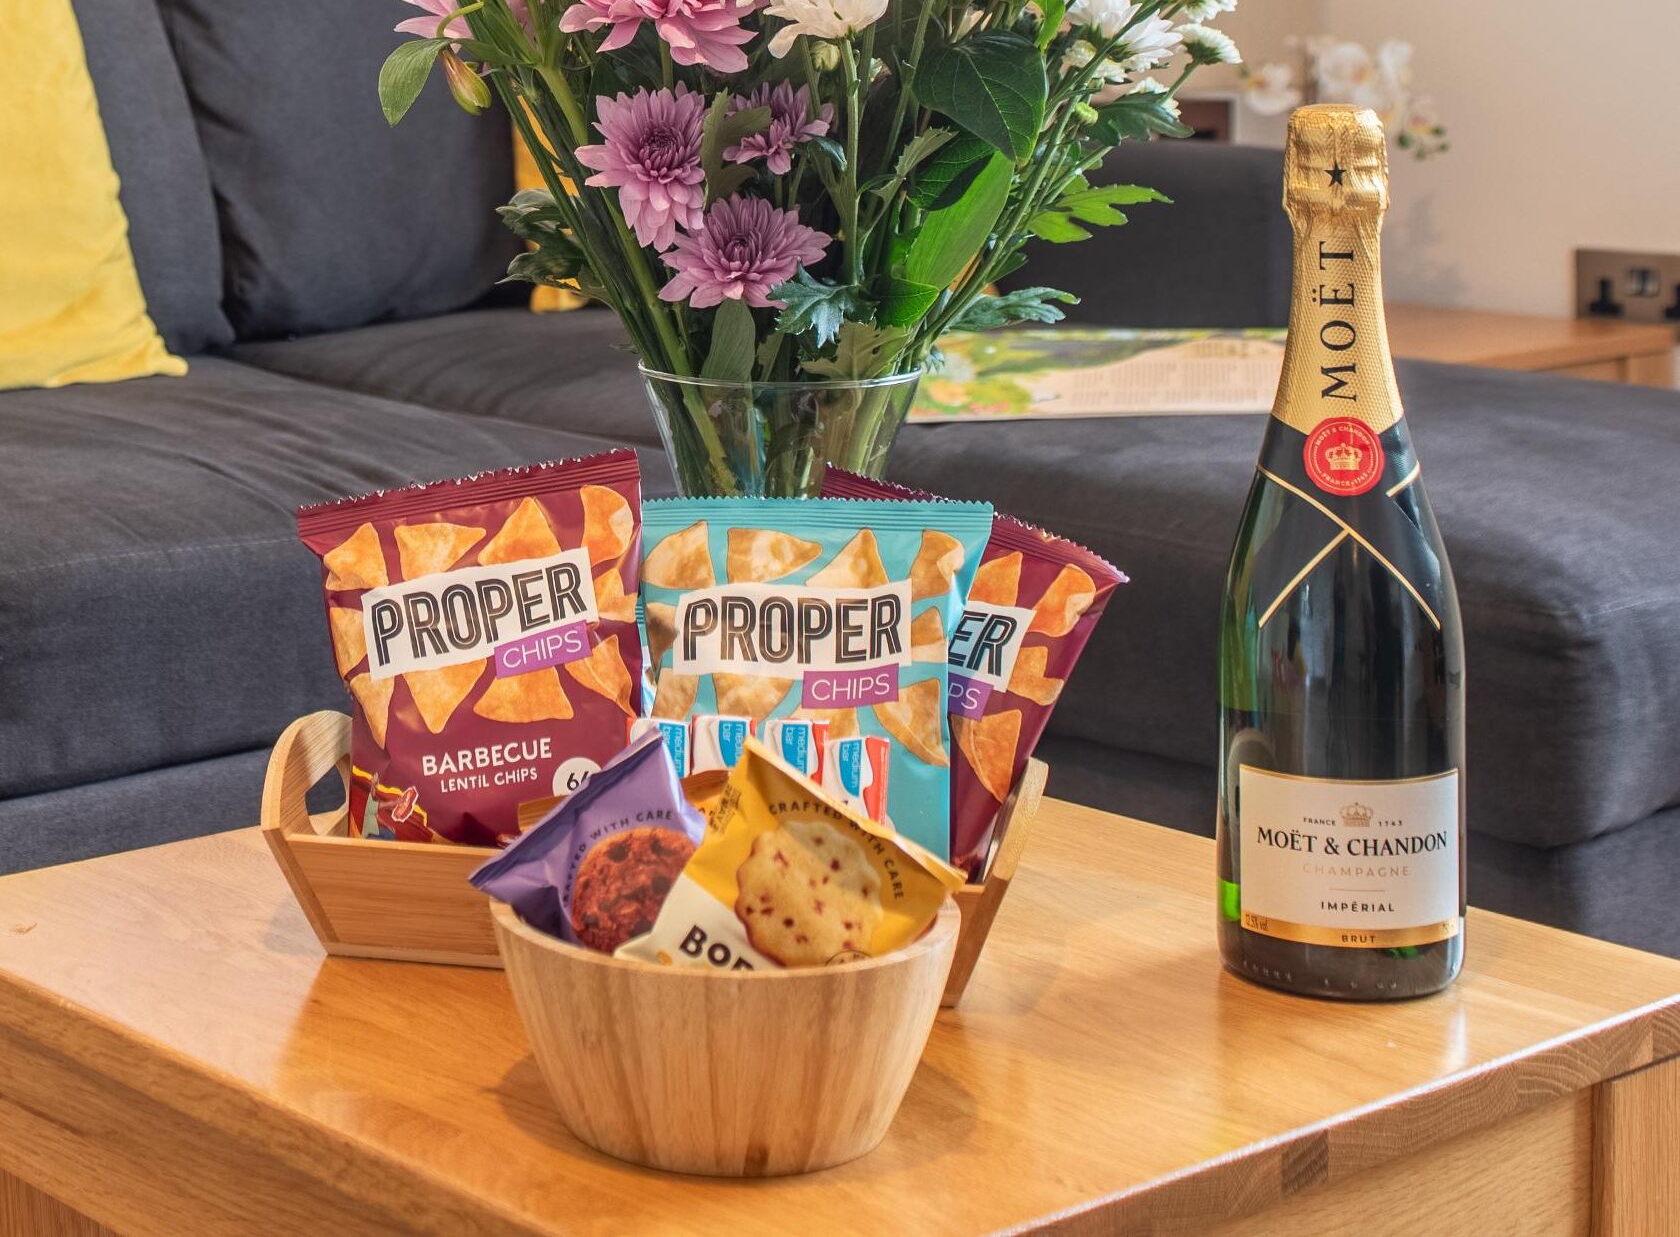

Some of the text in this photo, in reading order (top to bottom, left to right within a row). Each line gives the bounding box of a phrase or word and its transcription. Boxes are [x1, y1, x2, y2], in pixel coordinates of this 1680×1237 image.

[1312, 240, 1357, 402] MOËT
[371, 561, 588, 667] PROPER
[682, 593, 903, 664] PROPER
[502, 629, 582, 668] CHIPS
[948, 610, 1018, 677] ER
[811, 673, 890, 702] CHIPS
[948, 682, 982, 710] PS
[722, 723, 732, 742] bar
[785, 726, 794, 745] bar
[422, 738, 552, 776] BARBECUE
[842, 743, 850, 762] bar
[851, 741, 860, 789] medium
[590, 817, 630, 841] WITH
[636, 810, 673, 822] CARE
[1303, 817, 1336, 826] FRANCE
[769, 801, 843, 820] CRAFTED
[884, 858, 904, 900] CARE
[1257, 826, 1448, 857] MOËT & CHANDON
[1302, 862, 1409, 878] CHAMPAGNE
[1321, 900, 1395, 913] IMPÉRIAL
[1341, 934, 1377, 944] BRUT
